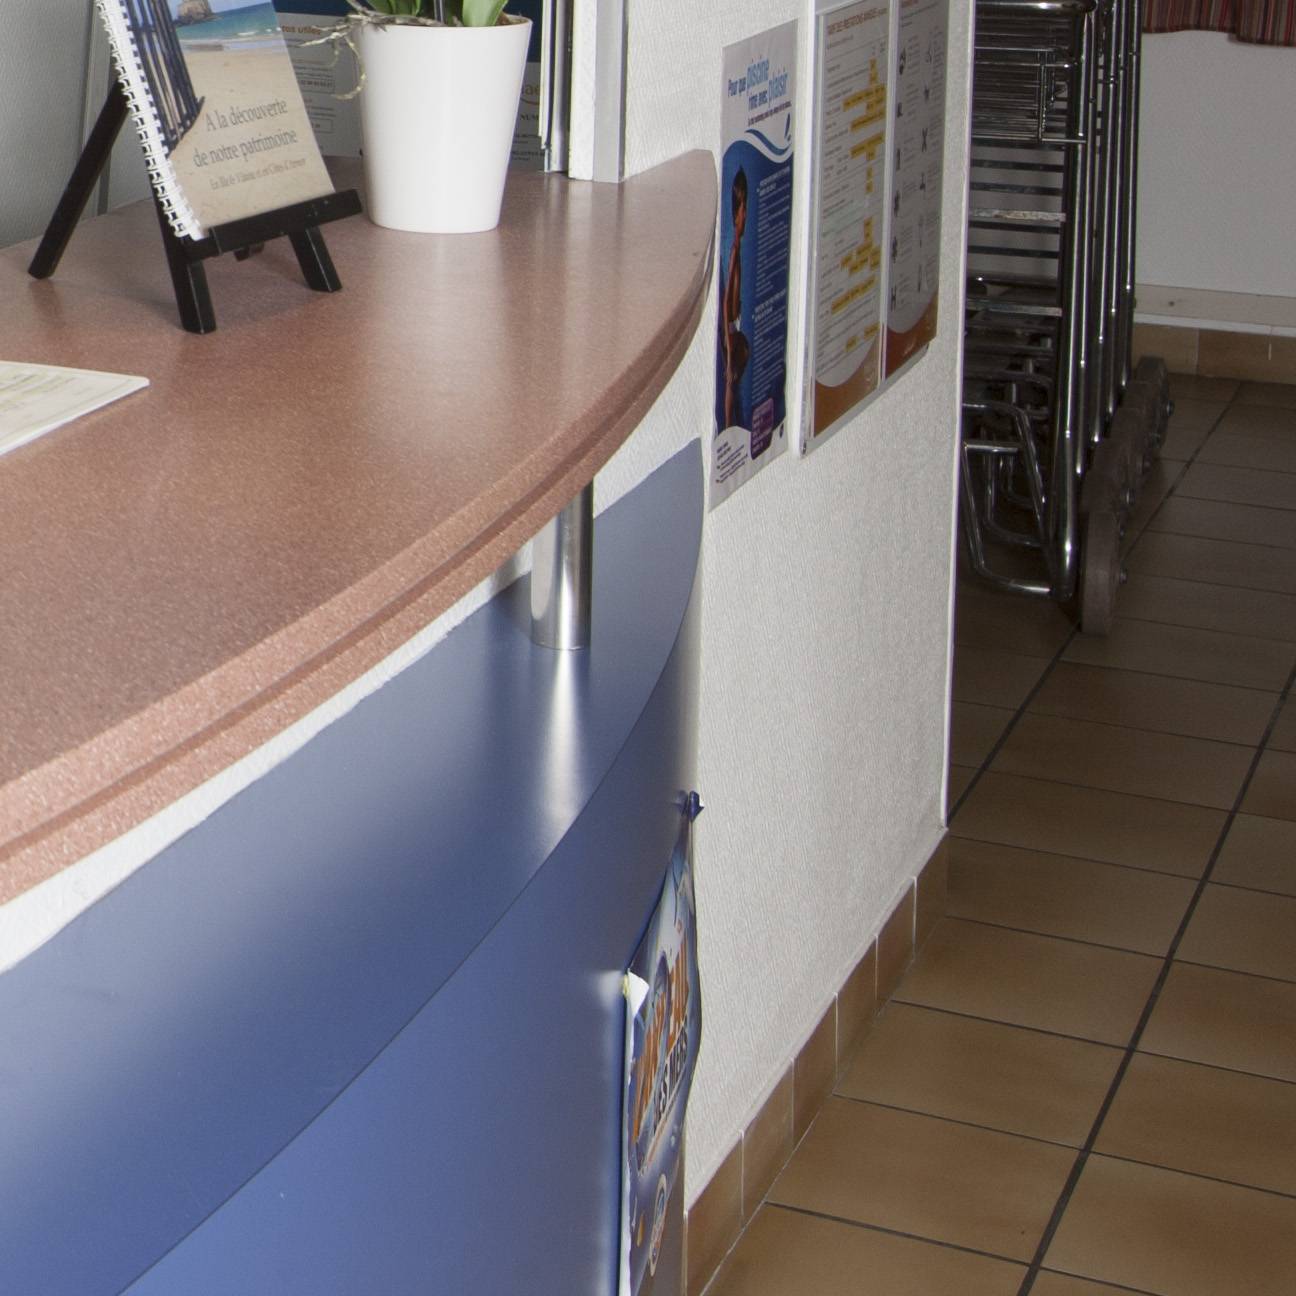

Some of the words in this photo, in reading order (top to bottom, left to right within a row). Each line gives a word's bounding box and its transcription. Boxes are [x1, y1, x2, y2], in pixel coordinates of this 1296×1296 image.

[747, 55, 769, 97] piscine
[768, 67, 788, 108] plaisir
[215, 110, 229, 129] la
[229, 98, 288, 126] découverte
[193, 148, 208, 168] de
[209, 144, 239, 164] notre
[239, 130, 298, 163] patrimoine
